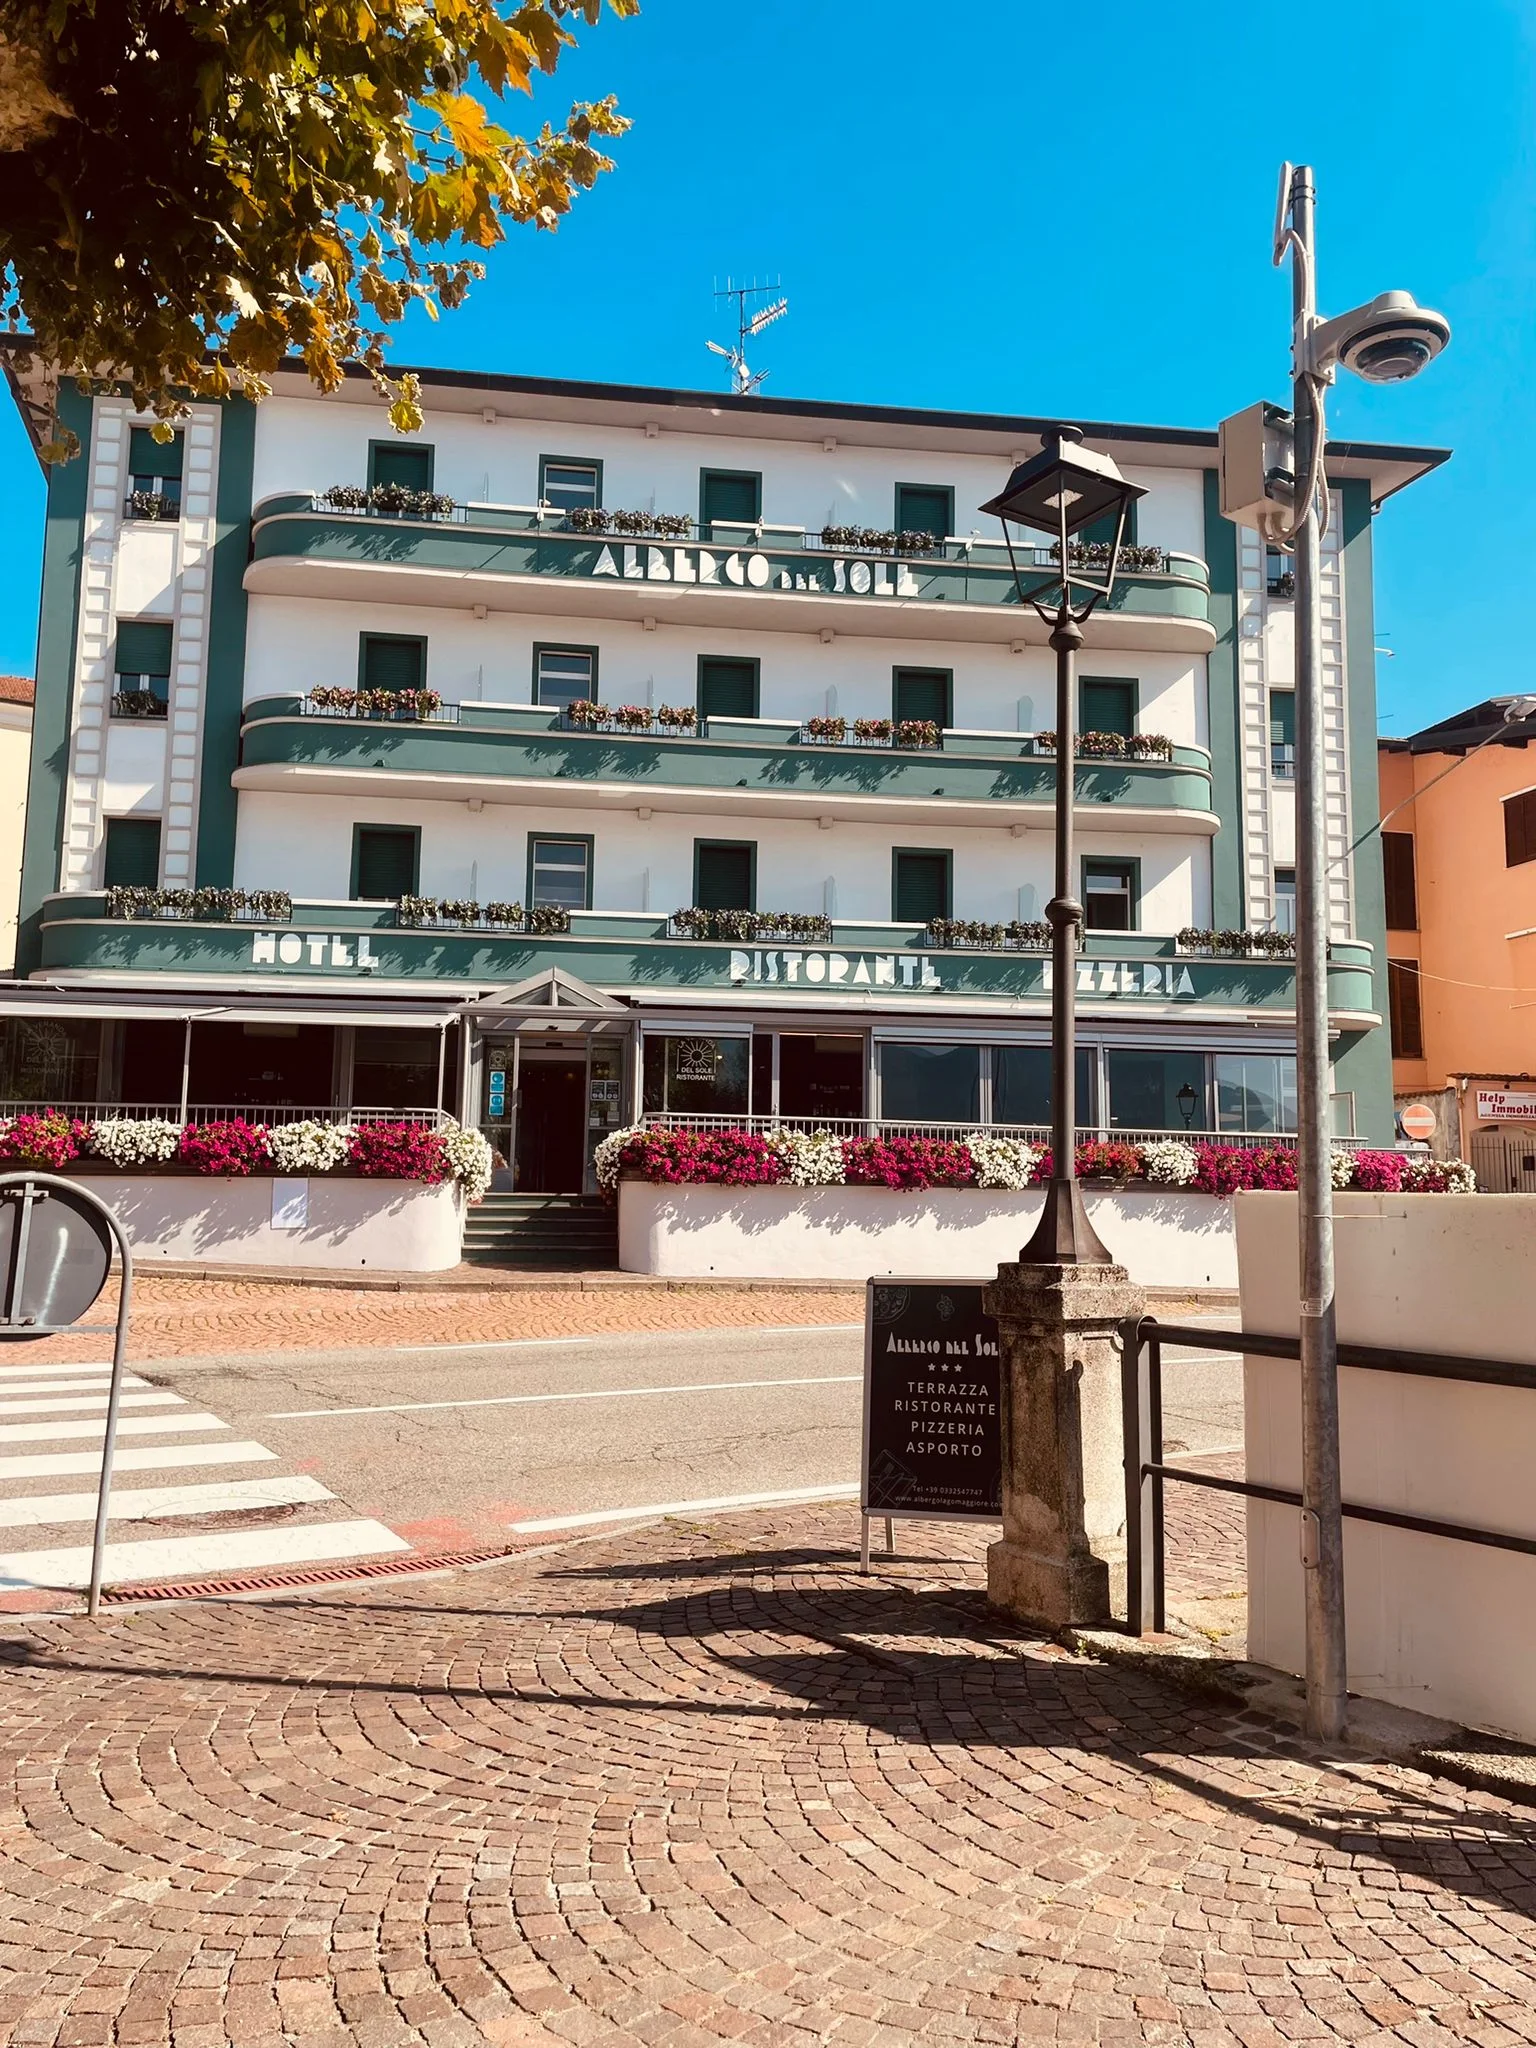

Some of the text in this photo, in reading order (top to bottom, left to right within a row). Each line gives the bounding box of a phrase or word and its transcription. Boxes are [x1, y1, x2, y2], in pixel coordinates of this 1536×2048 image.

[591, 543, 919, 597] ALBERGO DEL SOLE
[252, 932, 379, 968] HOTEL
[730, 950, 942, 987] RISTORANTE
[1042, 959, 1196, 995] PZZERIA
[1479, 1093, 1505, 1104] Help
[975, 1333, 999, 1356] SOL
[907, 1381, 989, 1397] TERRAZZA
[894, 1399, 996, 1416] RISTORANTE
[911, 1421, 985, 1436] PIZZERIA
[905, 1441, 982, 1457] ASPORTO
[912, 1485, 923, 1493] Tel
